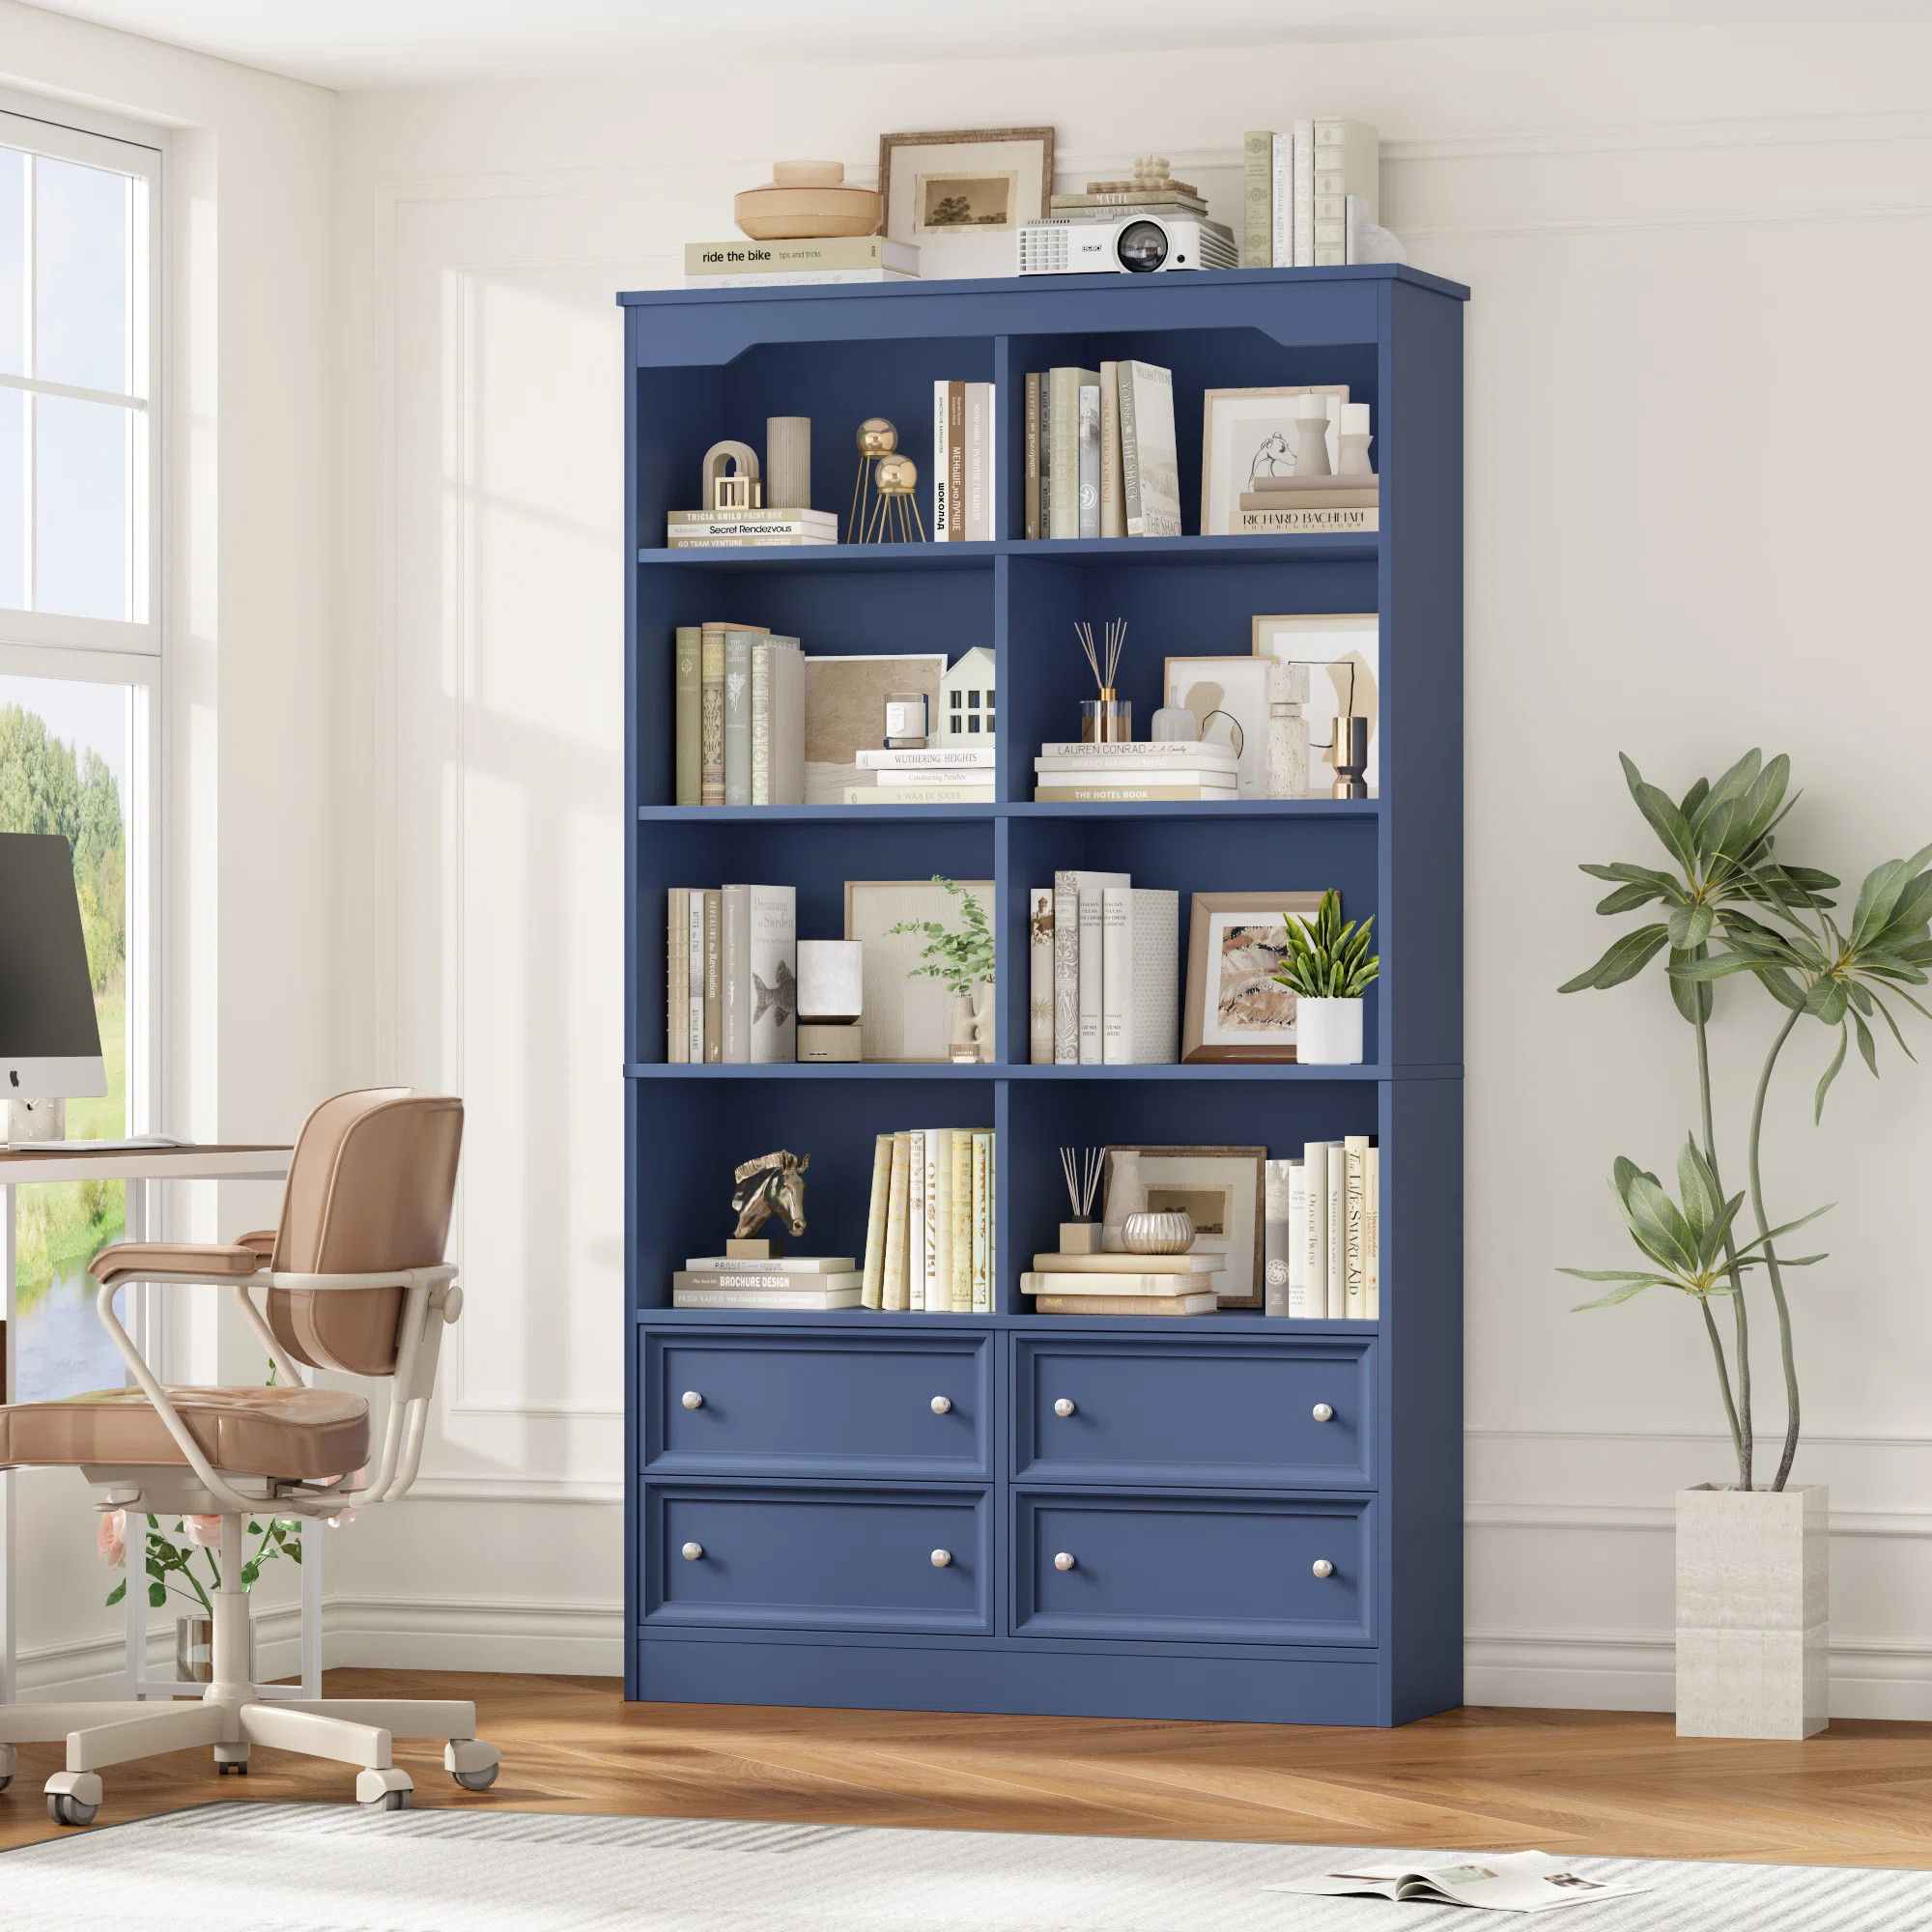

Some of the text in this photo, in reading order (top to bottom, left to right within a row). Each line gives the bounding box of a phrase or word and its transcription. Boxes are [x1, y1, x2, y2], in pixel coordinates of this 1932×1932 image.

[1096, 193, 1128, 205] MATTE
[702, 249, 771, 263] ride the bike
[779, 251, 790, 260] tips
[806, 249, 821, 258] tricks
[1122, 381, 1133, 424] YOUNG
[1122, 436, 1138, 502] THE SHACK
[1102, 469, 1111, 503] JUMBO
[687, 513, 715, 522] TRICIA
[767, 511, 782, 520] BOX
[952, 500, 961, 530] ЛУЧШЕ
[1243, 512, 1364, 526] RICHARD BACHMAN
[709, 525, 792, 534] Secret Rendezvous
[1146, 513, 1158, 533] THE
[1058, 745, 1146, 754] LAUREN CONRAD
[895, 753, 978, 763] WUTHERING HEIGHTS
[1072, 758, 1168, 768] BRAND MANAGEMENT
[938, 791, 961, 801] JOUER
[1122, 790, 1149, 799] BOOK
[753, 895, 788, 911] Dreaming
[764, 912, 793, 928] Sweden
[709, 953, 718, 998] Revolution
[1349, 1149, 1361, 1171] The
[1308, 1194, 1318, 1267] OLIVER TWIST
[720, 1276, 790, 1288] BROCHURE DESIGN
[700, 1294, 724, 1303] KAHLO
